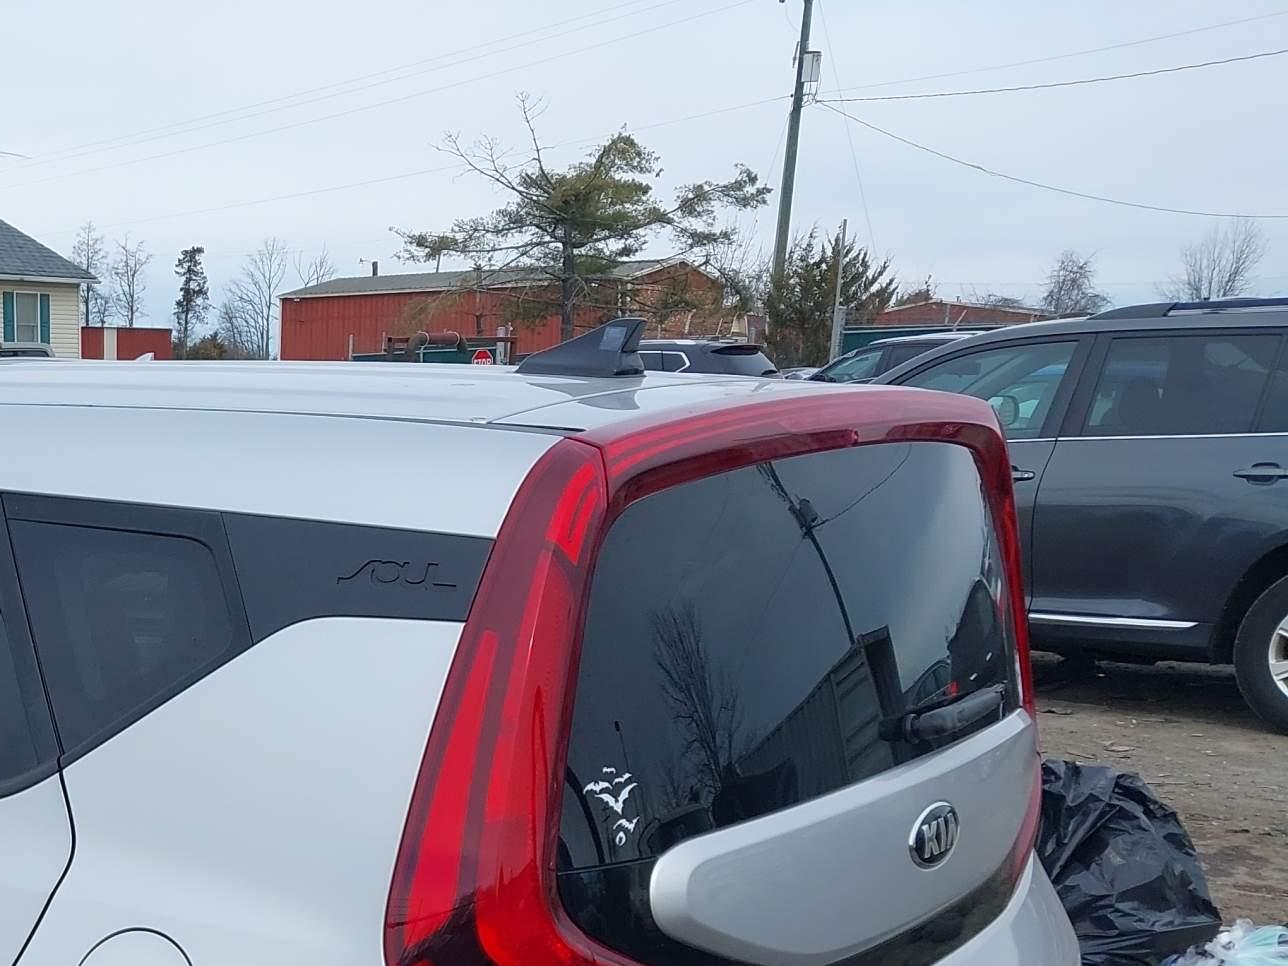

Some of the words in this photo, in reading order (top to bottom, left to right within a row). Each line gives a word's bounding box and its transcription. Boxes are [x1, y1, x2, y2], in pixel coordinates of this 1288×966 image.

[474, 357, 492, 366] STOP
[336, 559, 457, 590] SOUL
[922, 812, 957, 859] KIA
